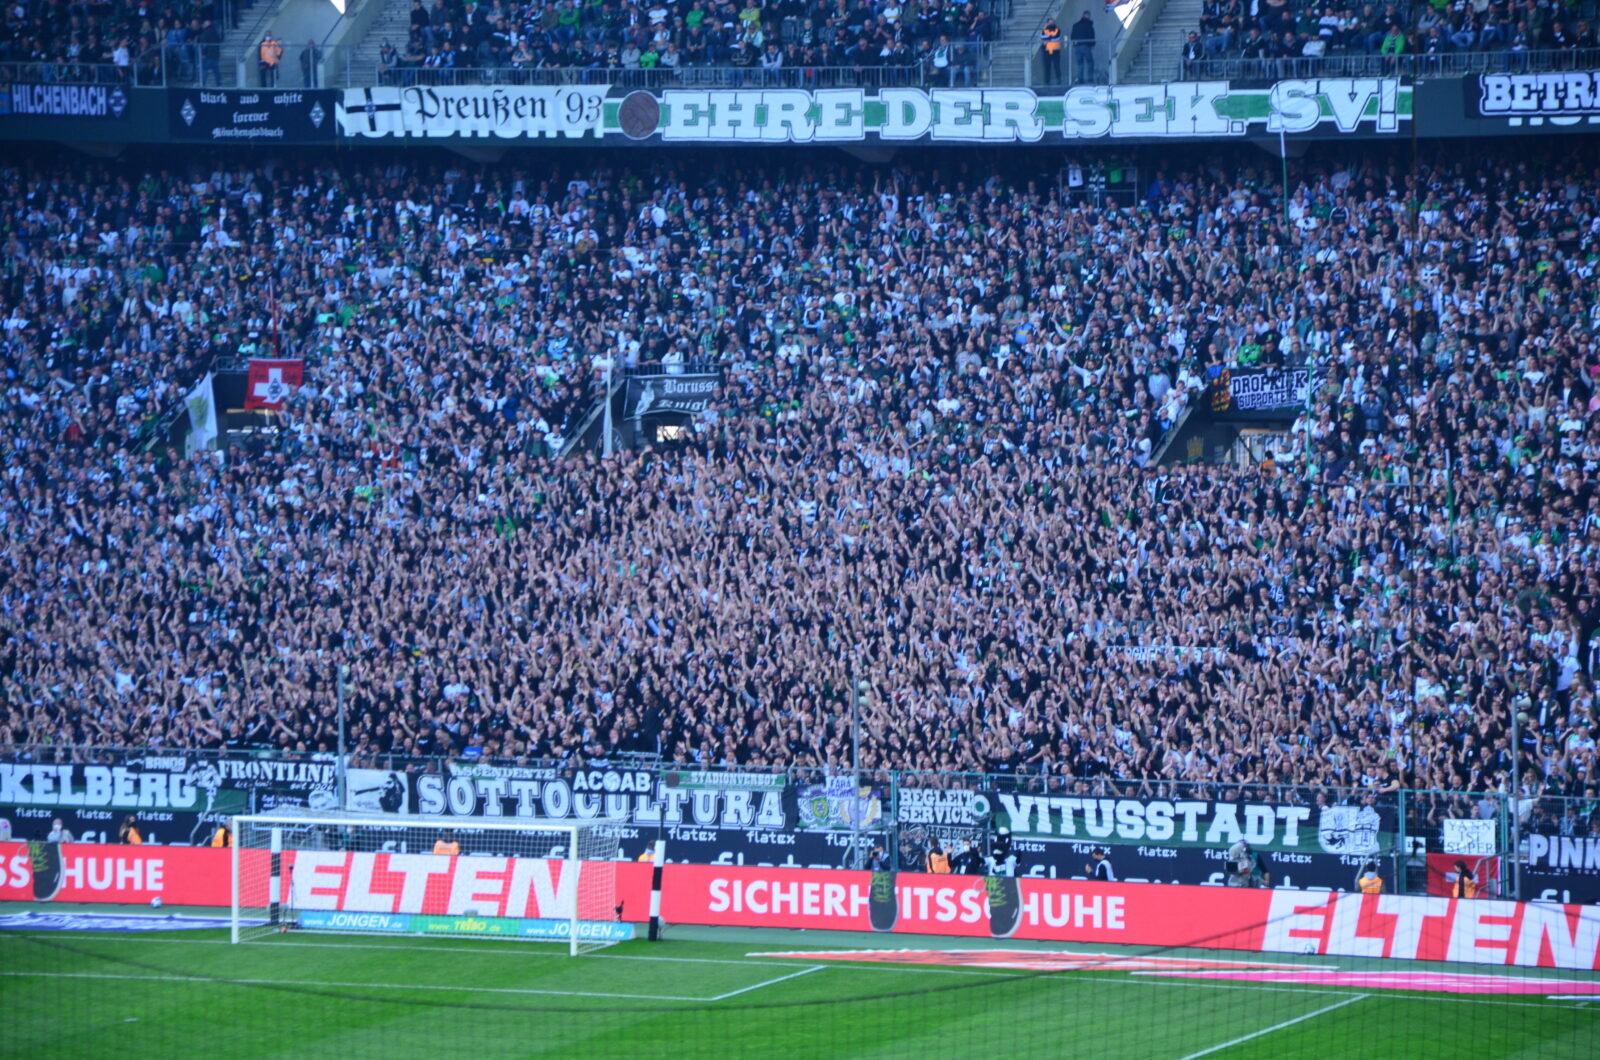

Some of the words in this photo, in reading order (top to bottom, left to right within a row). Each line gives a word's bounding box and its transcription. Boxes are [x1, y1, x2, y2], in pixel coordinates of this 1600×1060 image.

[11, 83, 107, 116] HILCHENBACH
[200, 91, 228, 104] black
[240, 93, 260, 104] and
[273, 92, 303, 106] white
[403, 87, 547, 126] Preußen
[662, 88, 865, 142] EHRE
[878, 87, 1045, 142] DER
[1063, 80, 1247, 139] SEK.
[1266, 76, 1401, 134] SV!
[232, 112, 270, 123] forever
[1231, 370, 1309, 396] DROPKIK
[1237, 389, 1299, 410] SUPPORTES
[217, 760, 336, 783] FRONTLINE
[449, 764, 557, 780] ASCENDENTE
[690, 771, 778, 787] STADIONVERBOT
[898, 788, 975, 806] BEGLEIT
[15, 807, 52, 818] flatex
[76, 809, 113, 820] flatex
[136, 810, 174, 821] flatex
[897, 806, 974, 825] SERVICE
[998, 793, 1311, 847] VITUSSTADT
[1449, 820, 1492, 831] YANN
[668, 827, 717, 842] flatex
[747, 830, 796, 845] flatex
[1460, 831, 1480, 842] IST
[1012, 842, 1046, 853] latex
[1071, 843, 1112, 855] flatx
[1137, 846, 1178, 858] flatex
[1446, 841, 1494, 854] SUPER
[1271, 852, 1313, 864] flatex
[286, 850, 583, 920] ELTEN
[708, 878, 1126, 931] SICHERHITSSHUHE
[326, 913, 391, 929] JONGEN
[1261, 889, 1600, 971] ELTEN
